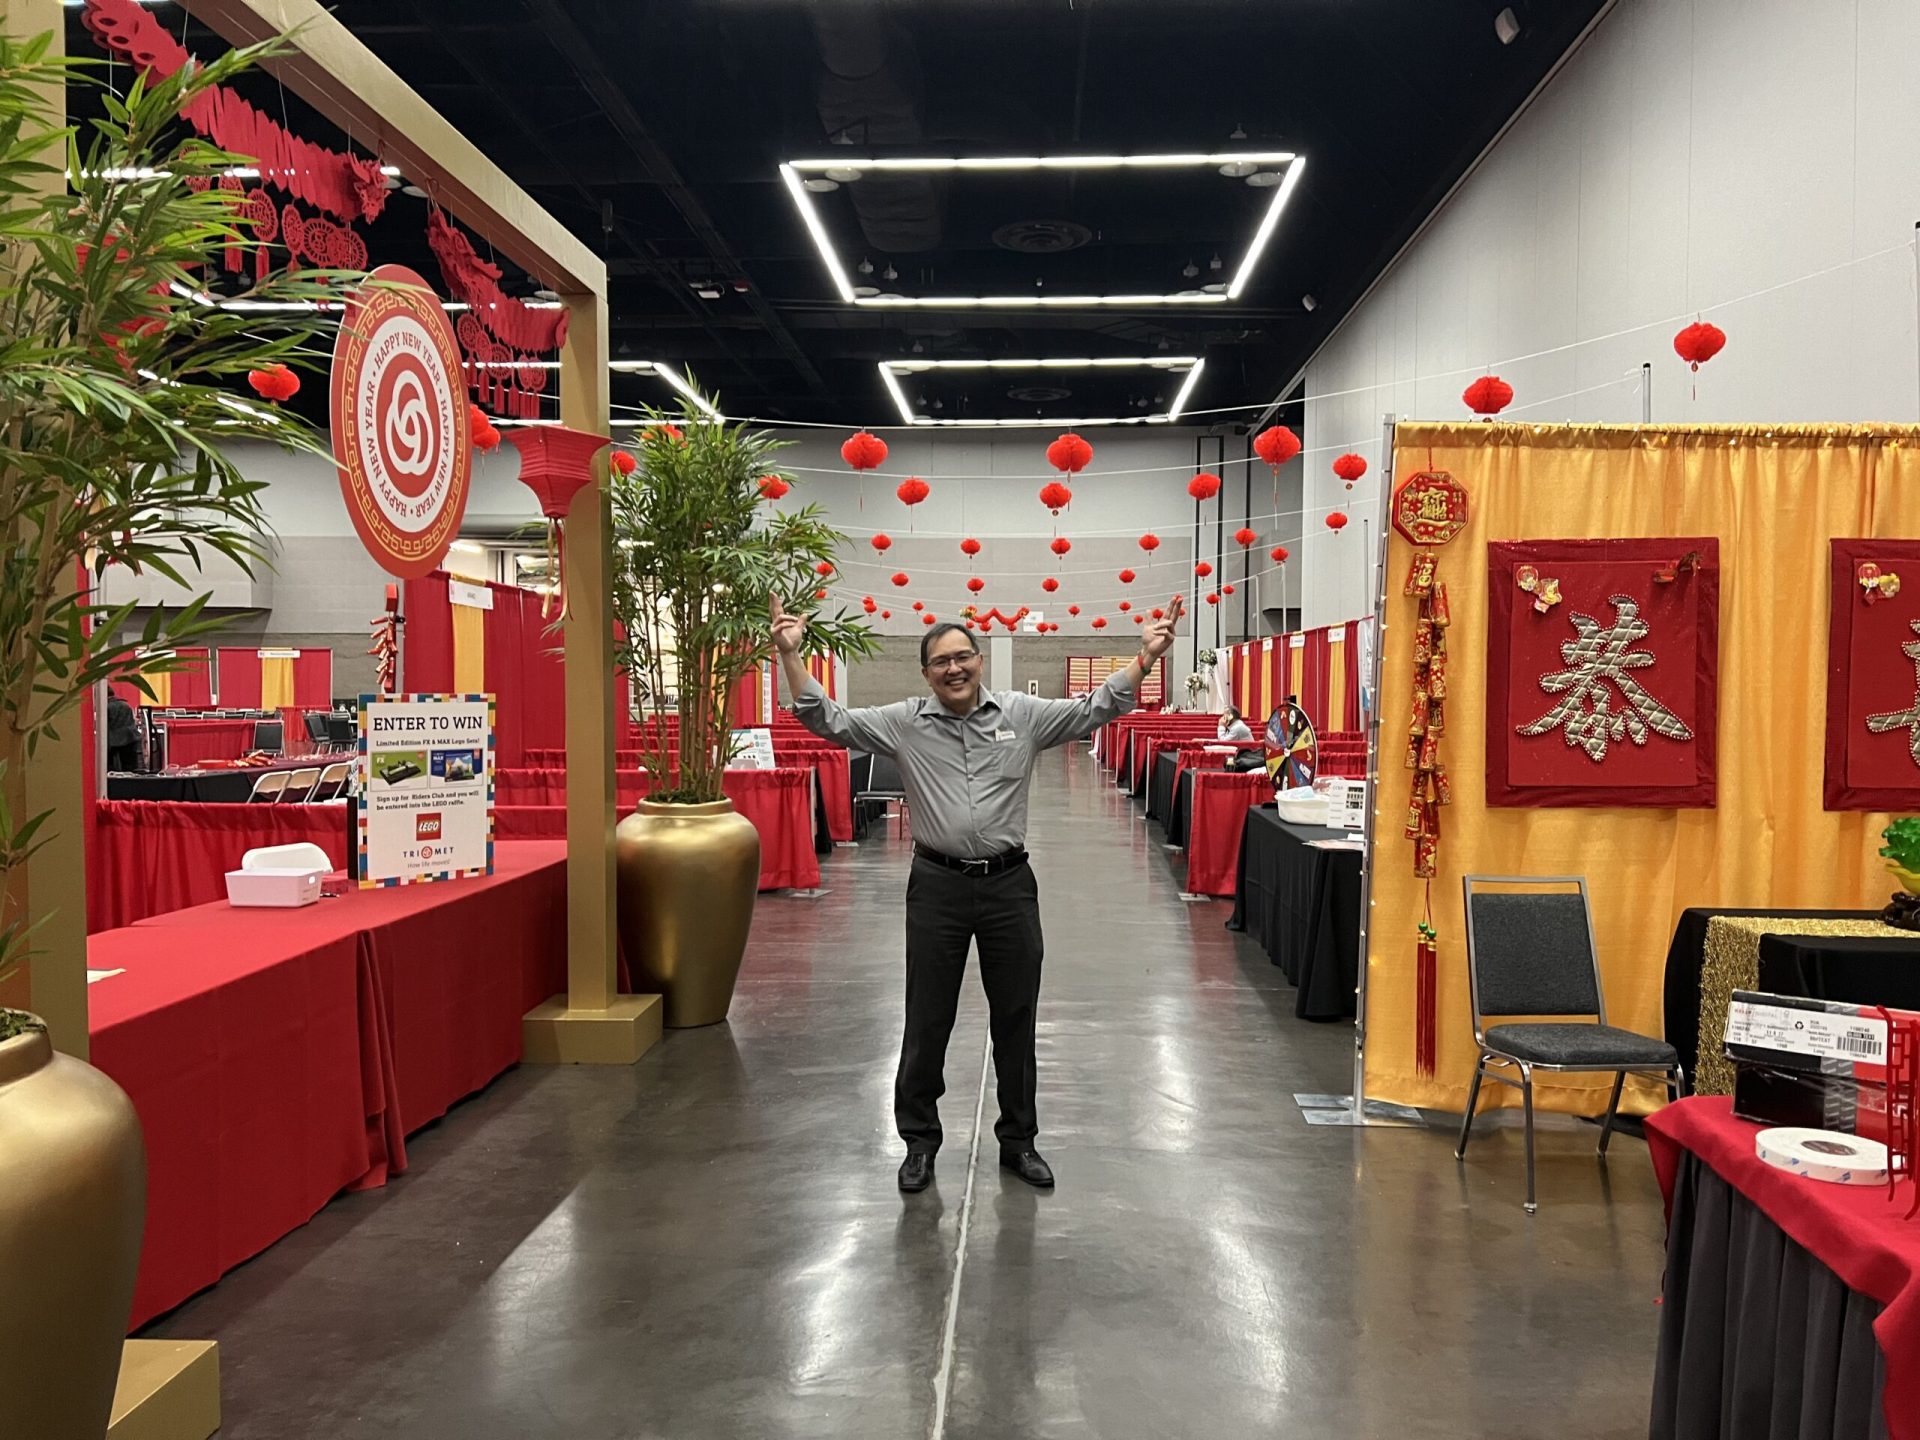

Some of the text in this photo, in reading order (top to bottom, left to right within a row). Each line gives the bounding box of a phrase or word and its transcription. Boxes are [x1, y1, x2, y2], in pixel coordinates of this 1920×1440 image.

[374, 331, 441, 385] HAPPY NEW YEAR
[366, 380, 407, 517] HAPPY NEW YEAR
[416, 400, 449, 517] HAPPY NEW YEAR
[373, 716, 483, 731] ENTER TO WIN
[418, 821, 439, 832] LEGO
[403, 847, 454, 858] TRI MET
